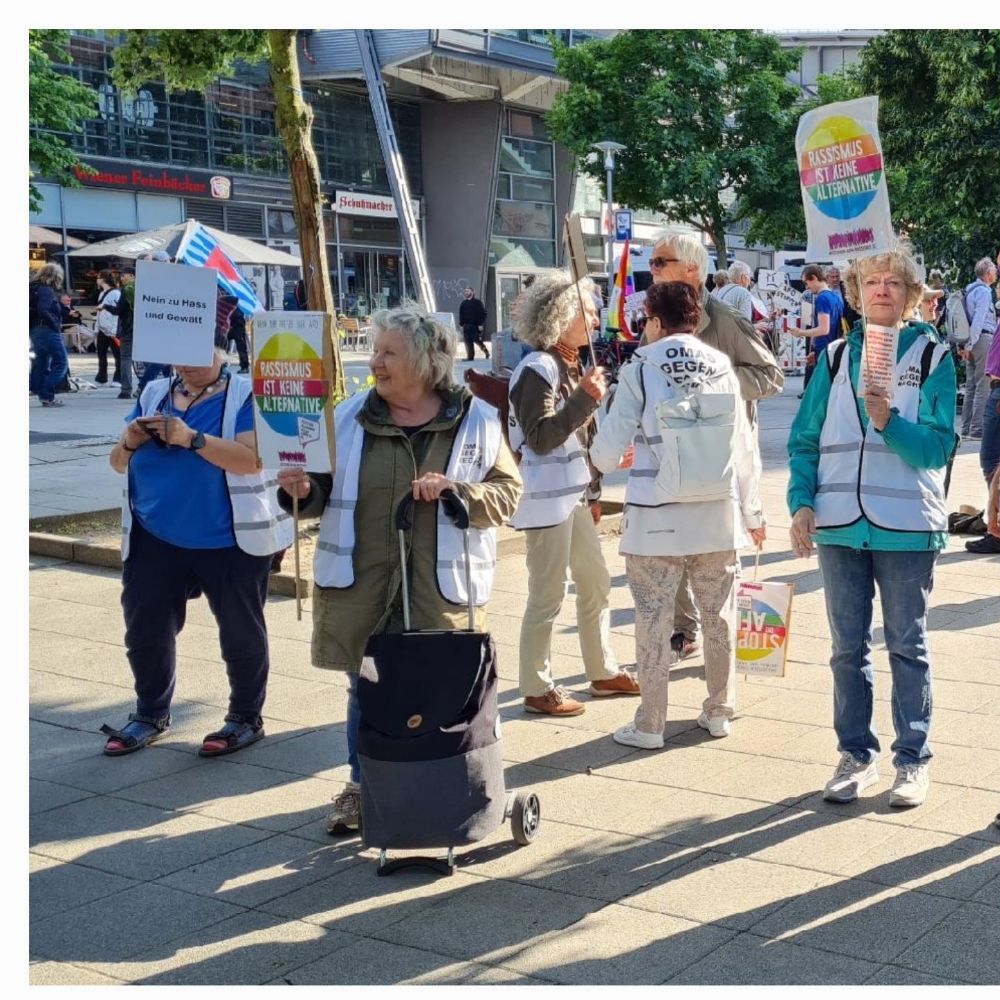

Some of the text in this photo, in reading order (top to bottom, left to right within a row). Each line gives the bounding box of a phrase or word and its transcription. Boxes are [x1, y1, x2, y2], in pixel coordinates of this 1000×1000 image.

[808, 140, 863, 168] RASSISMUS
[815, 159, 858, 183] IST KEINE
[816, 174, 877, 201] ALTERNATIVE
[142, 294, 166, 305] Nein
[182, 300, 207, 309] Hass
[145, 311, 203, 324] und Gewalt
[260, 361, 312, 378] RASSISMUS
[263, 379, 304, 395] IST KEINE
[262, 396, 321, 413] ALTERNATIVE
